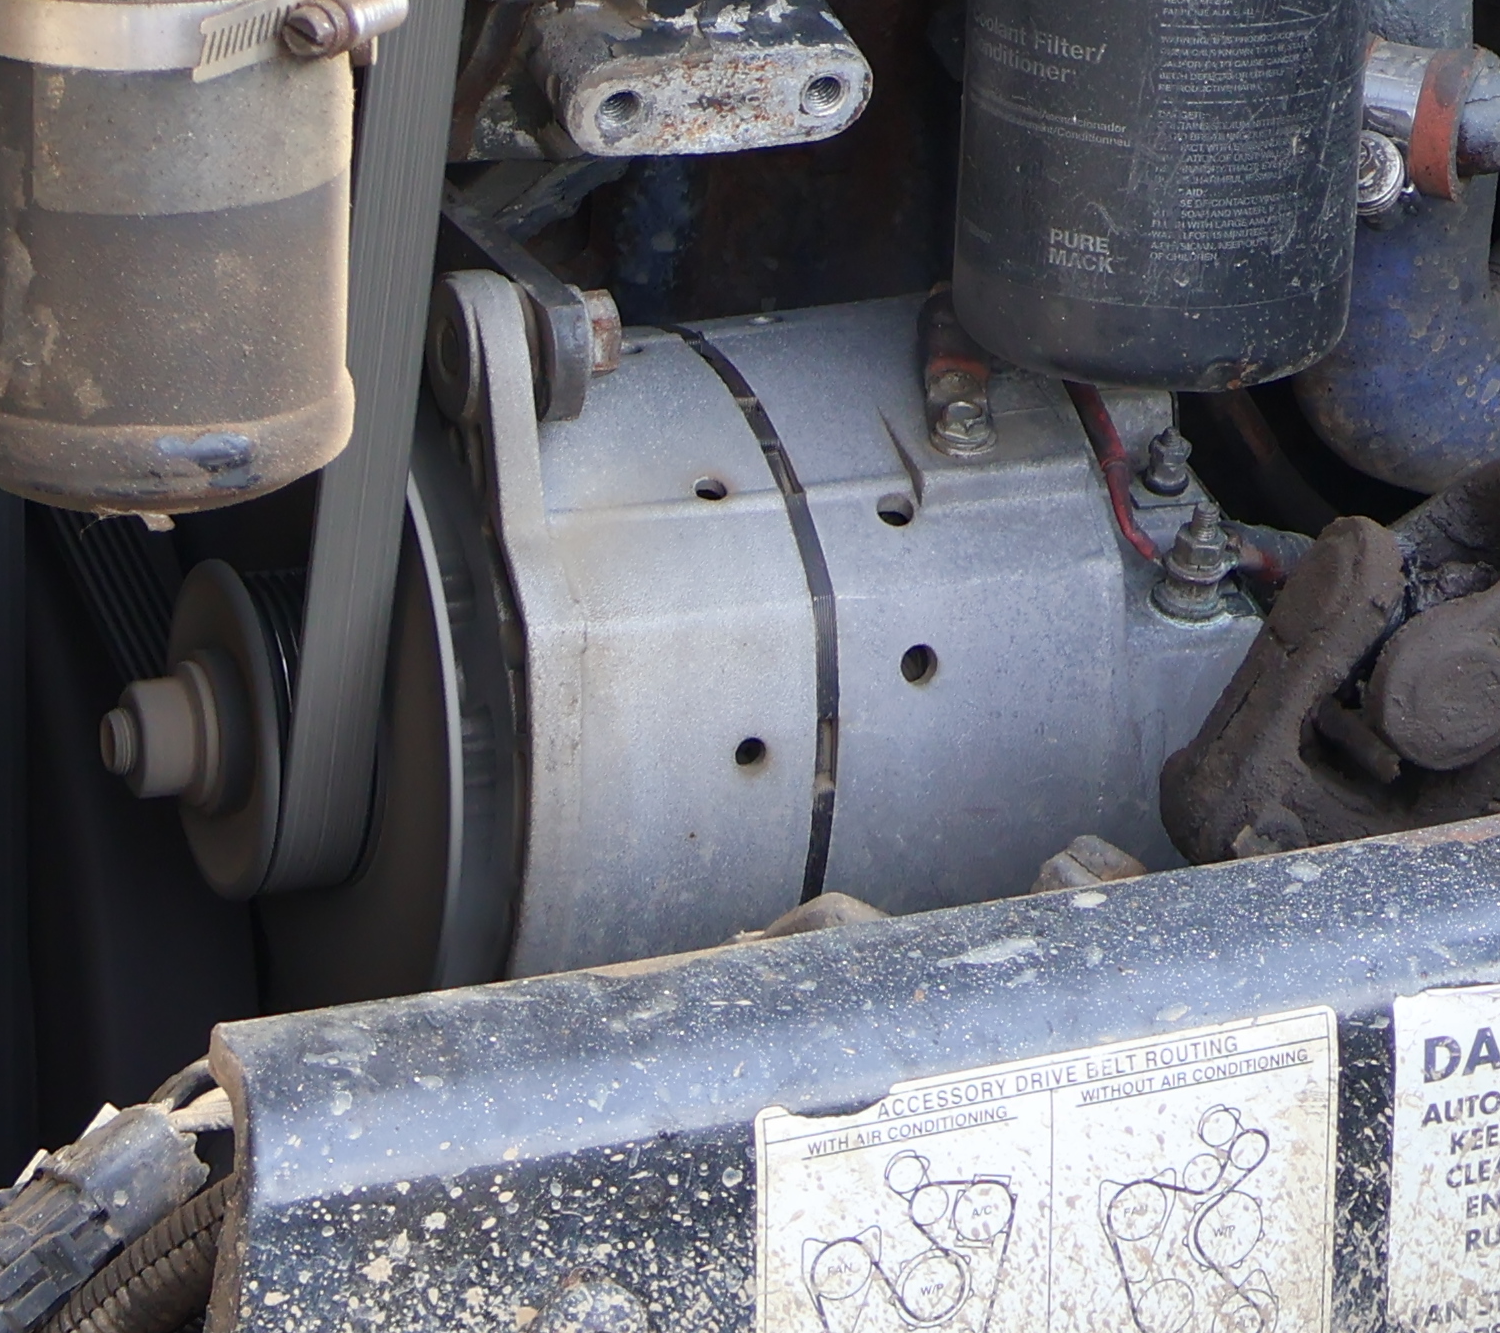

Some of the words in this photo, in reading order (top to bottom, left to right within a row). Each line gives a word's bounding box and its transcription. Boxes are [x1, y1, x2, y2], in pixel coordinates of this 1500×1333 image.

[1033, 29, 1109, 65] Filter/
[1049, 227, 1111, 256] PURE
[1048, 246, 1117, 275] MACK
[876, 1078, 1008, 1120] ACCESSORY
[1014, 1064, 1078, 1093] DRIVE
[1085, 1053, 1137, 1080] BELT
[1144, 1035, 1239, 1069] ROUTING
[1080, 1077, 1155, 1104] WITHOUT
[1160, 1072, 1188, 1089] AIR
[1191, 1048, 1309, 1084] CONDITIONING
[807, 1136, 850, 1157] WITH
[856, 1129, 883, 1147] AIR
[886, 1105, 1009, 1142] CONDITIONING
[971, 1204, 993, 1217] A/C
[827, 1262, 854, 1277] FAN
[920, 1283, 945, 1297] W/P
